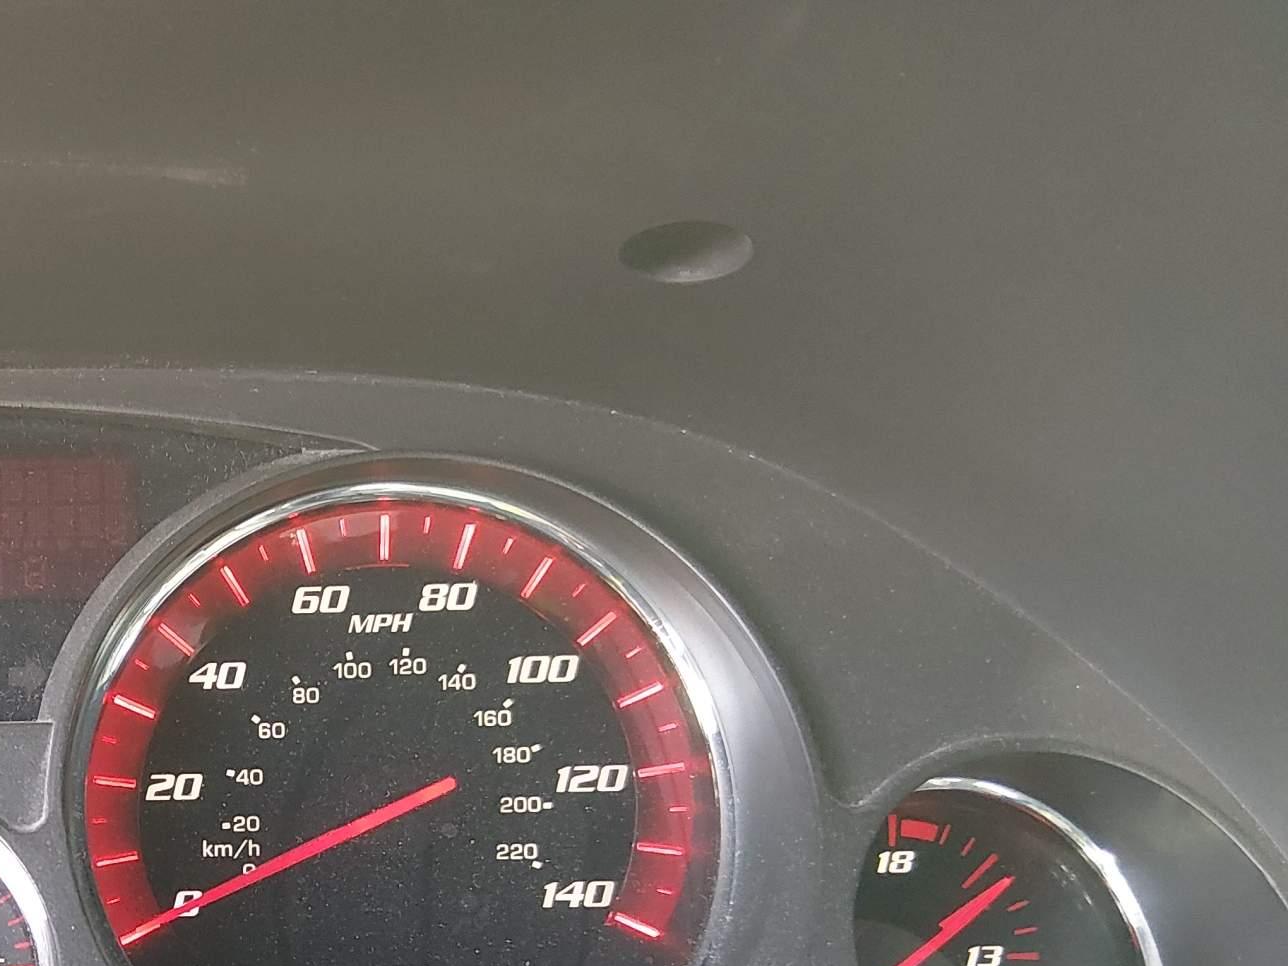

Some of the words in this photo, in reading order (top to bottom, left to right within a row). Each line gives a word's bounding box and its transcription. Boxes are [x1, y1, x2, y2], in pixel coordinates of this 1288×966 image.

[291, 585, 351, 614] 60
[418, 580, 478, 612] 80
[348, 612, 414, 634] MPH
[188, 661, 247, 690] 40
[332, 661, 372, 679] 100
[388, 657, 427, 675] 120
[507, 654, 580, 684] 100
[438, 673, 477, 691] 140
[292, 687, 320, 704] 80
[473, 709, 512, 727] 160
[258, 722, 286, 739] 60
[492, 746, 531, 764] 180
[235, 768, 264, 786] 40
[555, 764, 629, 793] 120
[145, 772, 203, 802] 20
[500, 796, 541, 813] 200
[233, 815, 260, 832] 20
[202, 839, 260, 859] km/h
[496, 842, 539, 861] 220
[877, 850, 916, 874] 18
[173, 890, 203, 917] 0
[542, 880, 615, 908] 140
